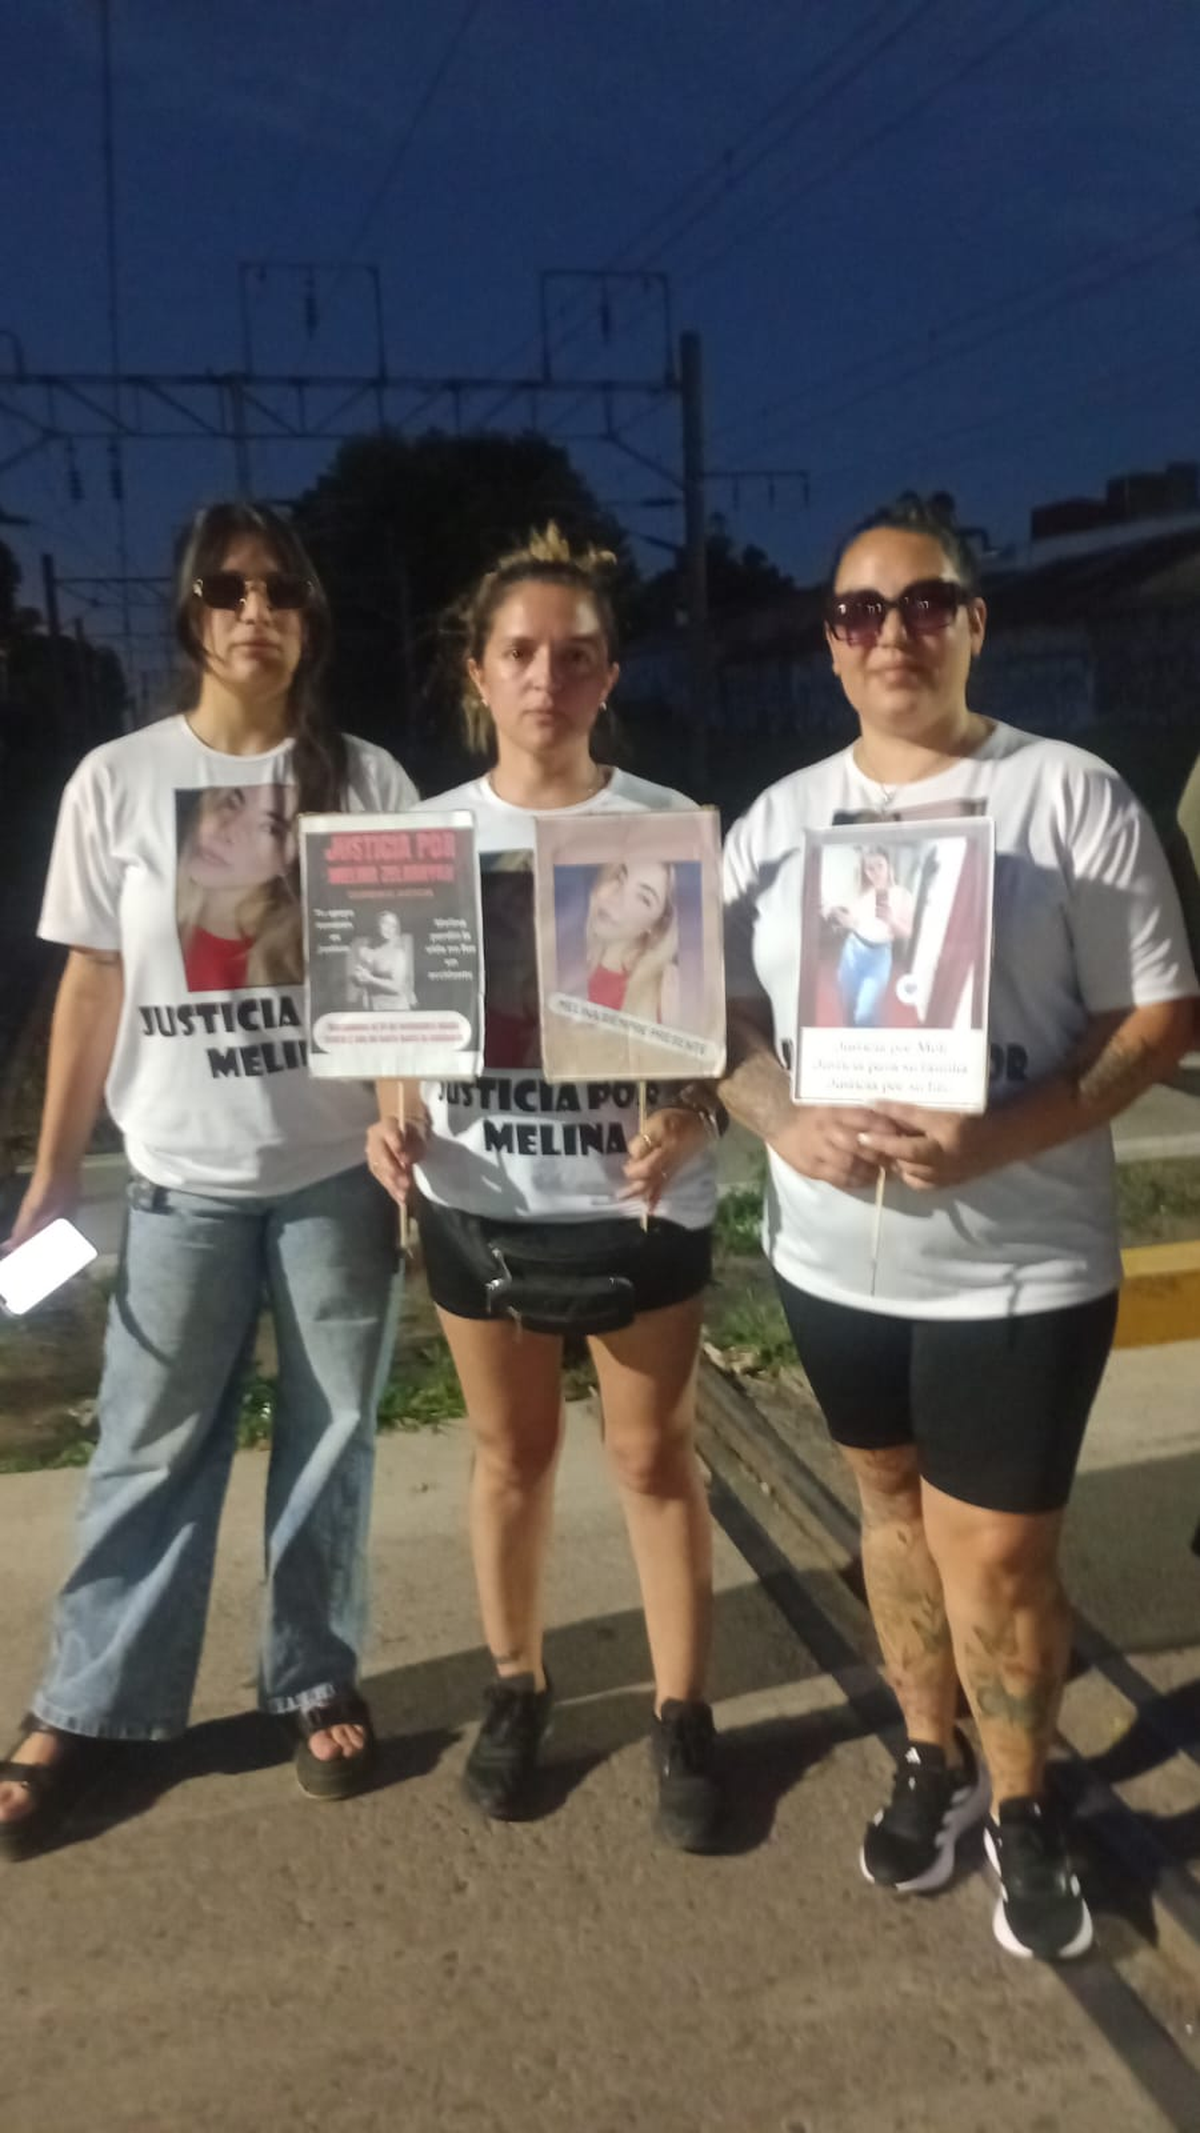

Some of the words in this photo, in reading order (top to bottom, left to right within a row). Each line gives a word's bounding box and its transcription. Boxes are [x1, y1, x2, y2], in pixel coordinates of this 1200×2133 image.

[326, 833, 411, 861] JUSTICIA
[416, 830, 455, 859] POR
[139, 996, 302, 1037] JUSTICIA
[439, 1078, 580, 1112] JUSTICIA
[587, 1080, 659, 1110] POR
[483, 1117, 629, 1156] MELINA
